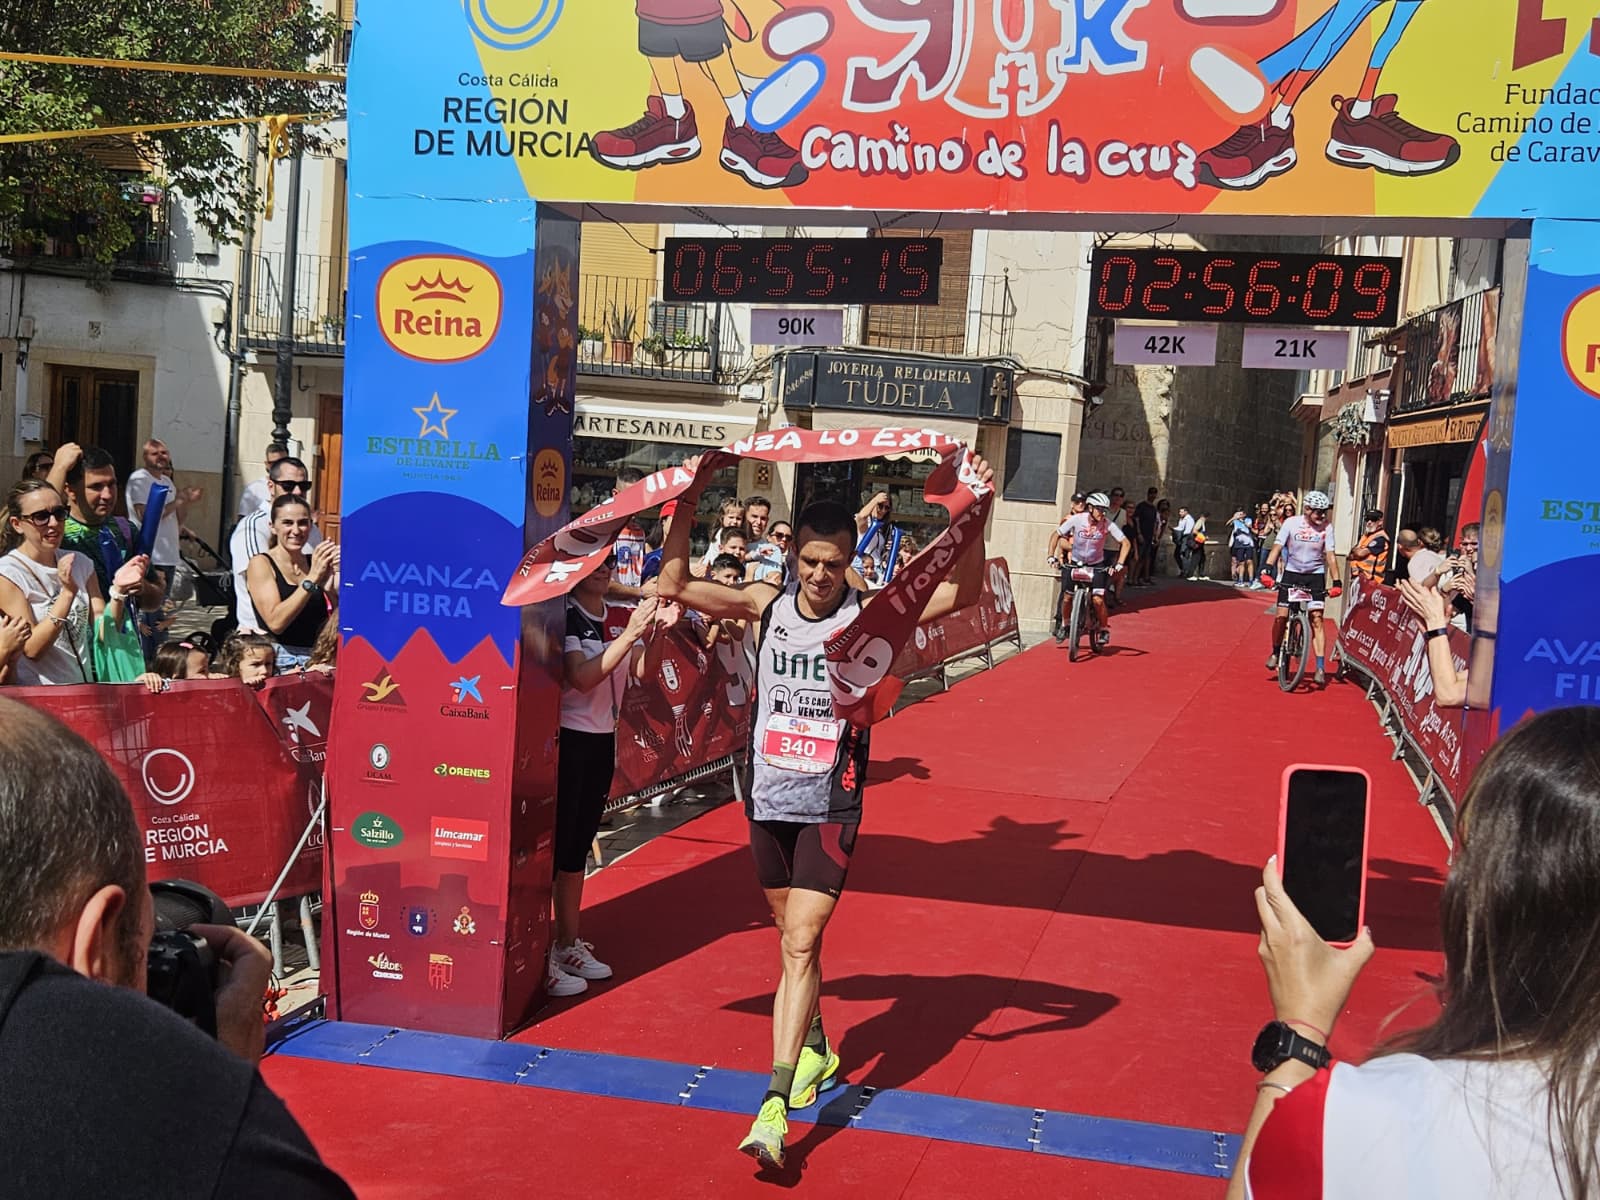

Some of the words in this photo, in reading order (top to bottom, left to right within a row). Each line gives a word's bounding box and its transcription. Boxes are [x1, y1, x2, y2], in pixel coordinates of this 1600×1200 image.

[458, 73, 504, 88] Costa
[508, 72, 559, 88] Cálida
[442, 93, 569, 126] REGIÓN
[1457, 112, 1553, 133] Camino
[1560, 112, 1591, 133] de
[414, 128, 455, 157] DE
[465, 129, 592, 160] MURCIA
[1490, 140, 1521, 162] de
[802, 122, 965, 173] Camino
[978, 135, 1024, 179] de
[1048, 123, 1085, 176] la
[1098, 141, 1197, 189] cruz
[671, 244, 929, 298] 06:55:15
[1098, 255, 1392, 320] 02:56:09
[394, 308, 482, 338] Reina
[777, 317, 815, 336] 90K
[1143, 334, 1186, 355] 42K
[1273, 338, 1317, 359] 21K
[828, 360, 884, 378] JOYERIA
[894, 366, 972, 384] RELOJERIA
[842, 379, 954, 410] TUDELA
[574, 416, 726, 441] ARTESANALES
[819, 428, 860, 447] LO
[366, 436, 502, 461] ESTRELLA
[416, 459, 470, 470] LEVANTE
[536, 484, 560, 501] Reina
[384, 590, 473, 618] FIBRA
[440, 706, 490, 720] CaixaBank
[780, 736, 816, 757] 340
[449, 766, 490, 778] ORENES
[152, 816, 171, 824] Costa
[172, 813, 199, 823] Cálida
[146, 824, 209, 845] REGIÓN
[360, 827, 394, 840] Salzillo
[434, 827, 484, 842] Limcamar
[161, 838, 229, 860] MURCIA
[346, 929, 365, 937] Región
